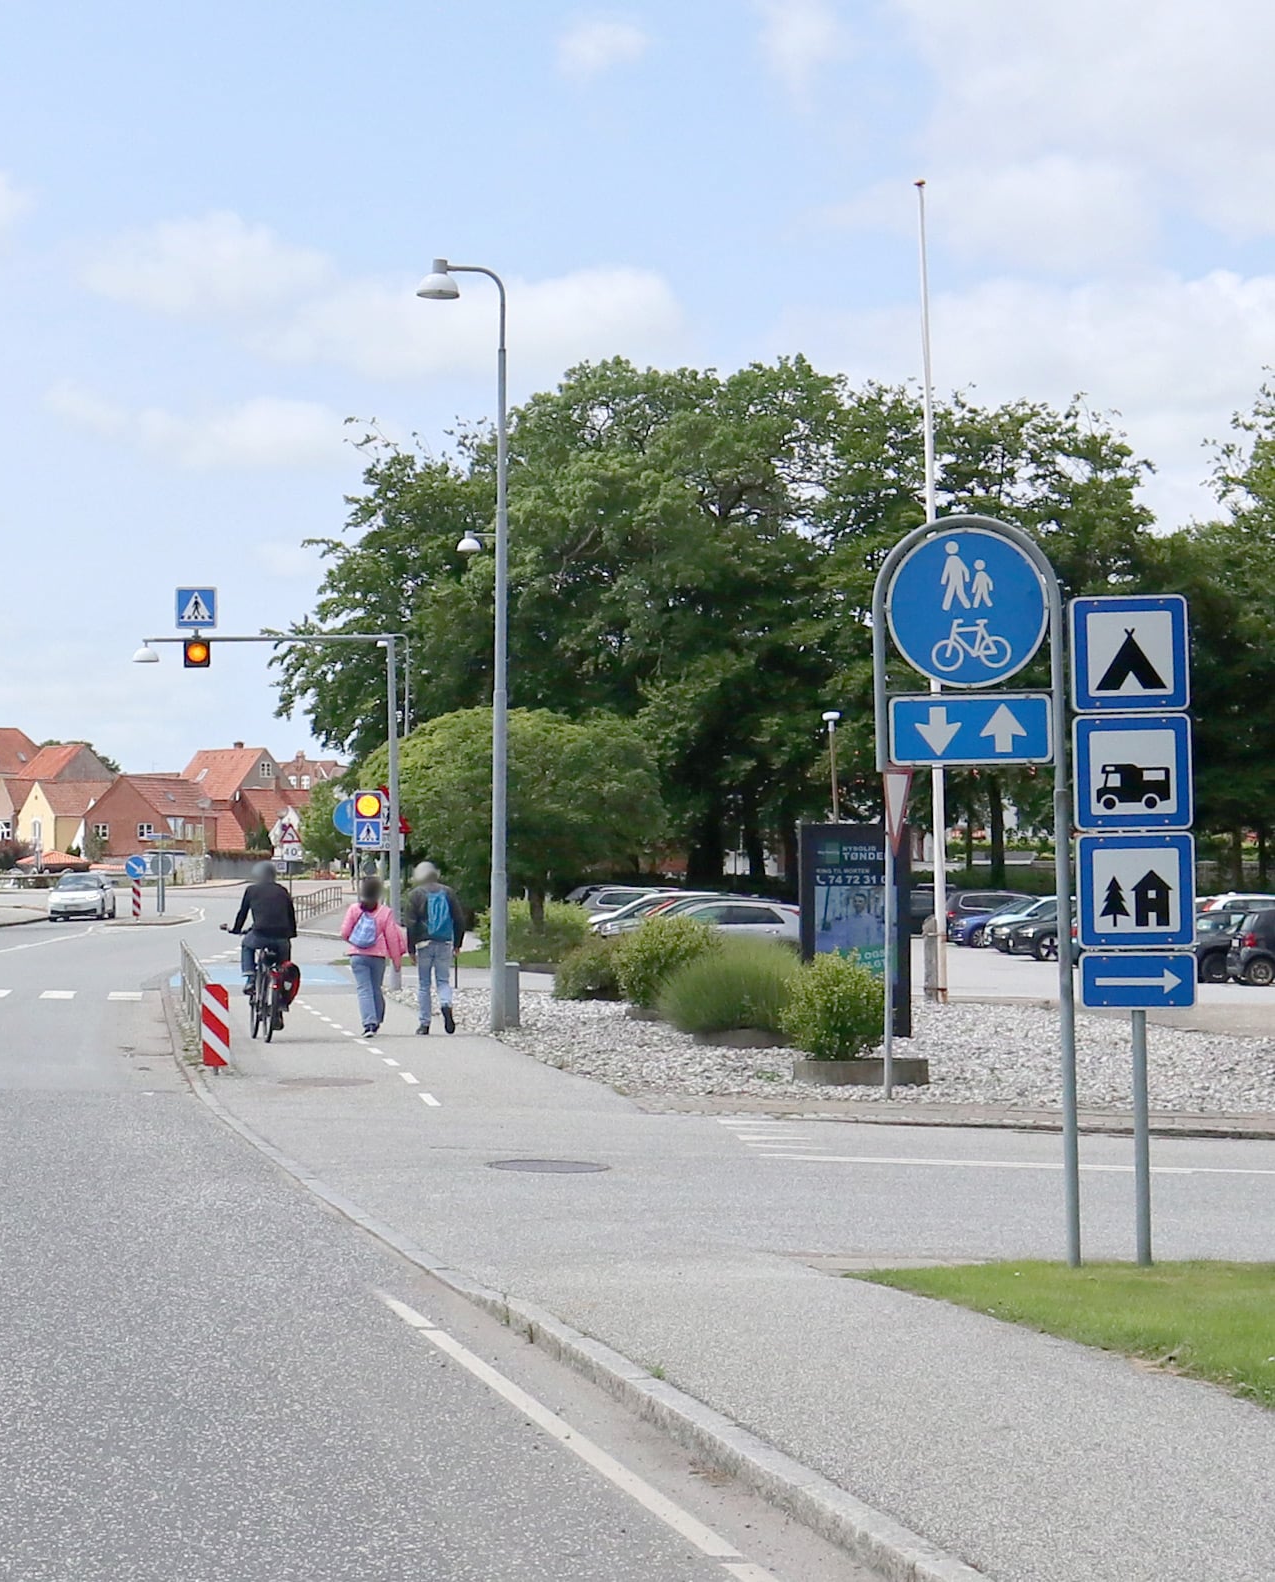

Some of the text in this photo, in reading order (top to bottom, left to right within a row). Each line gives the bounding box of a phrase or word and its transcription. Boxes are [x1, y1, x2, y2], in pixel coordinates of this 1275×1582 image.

[284, 847, 298, 856] 40
[842, 852, 885, 861] TØNDE
[828, 875, 843, 884] 74
[846, 875, 861, 884] 72
[863, 875, 877, 884] 31
